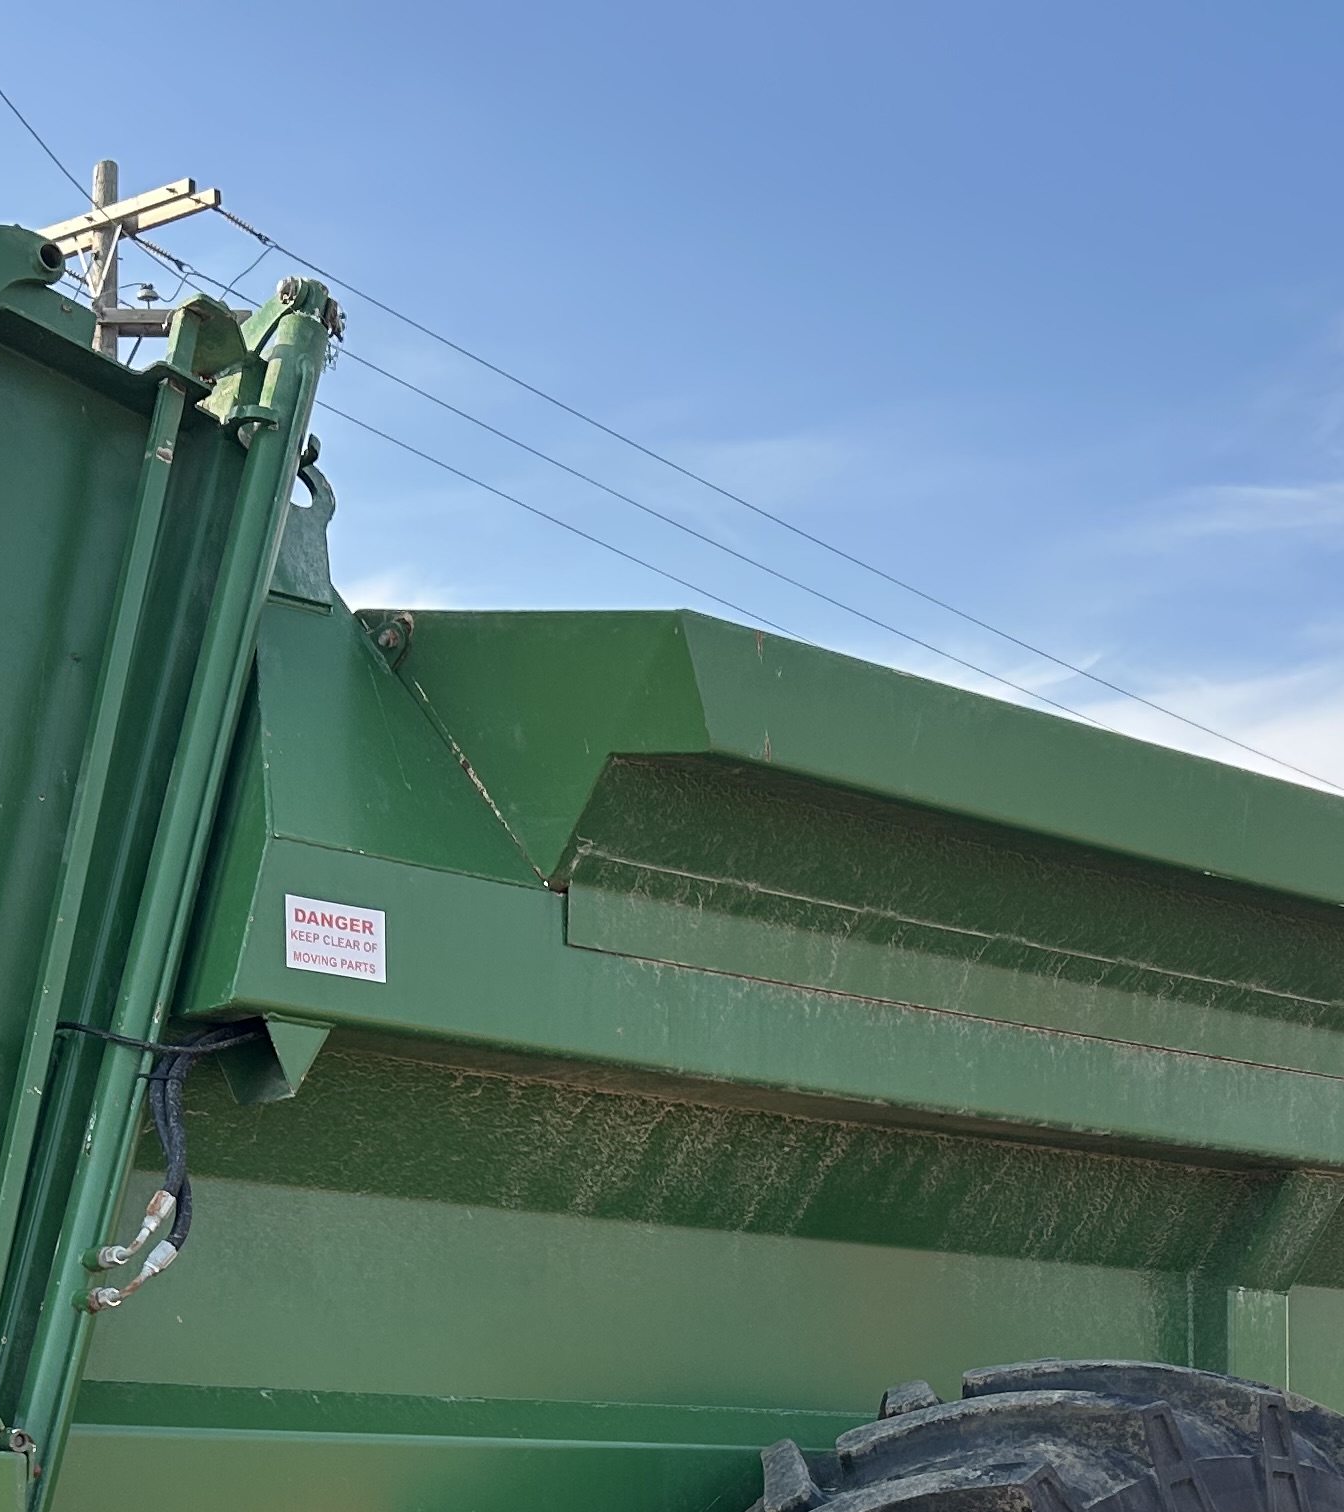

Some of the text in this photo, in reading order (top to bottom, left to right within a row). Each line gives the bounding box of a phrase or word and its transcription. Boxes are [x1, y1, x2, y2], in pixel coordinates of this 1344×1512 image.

[294, 908, 375, 935] DANGER
[290, 929, 378, 954] KEEP CLEAR OF
[293, 951, 376, 975] MOVING PARTS
